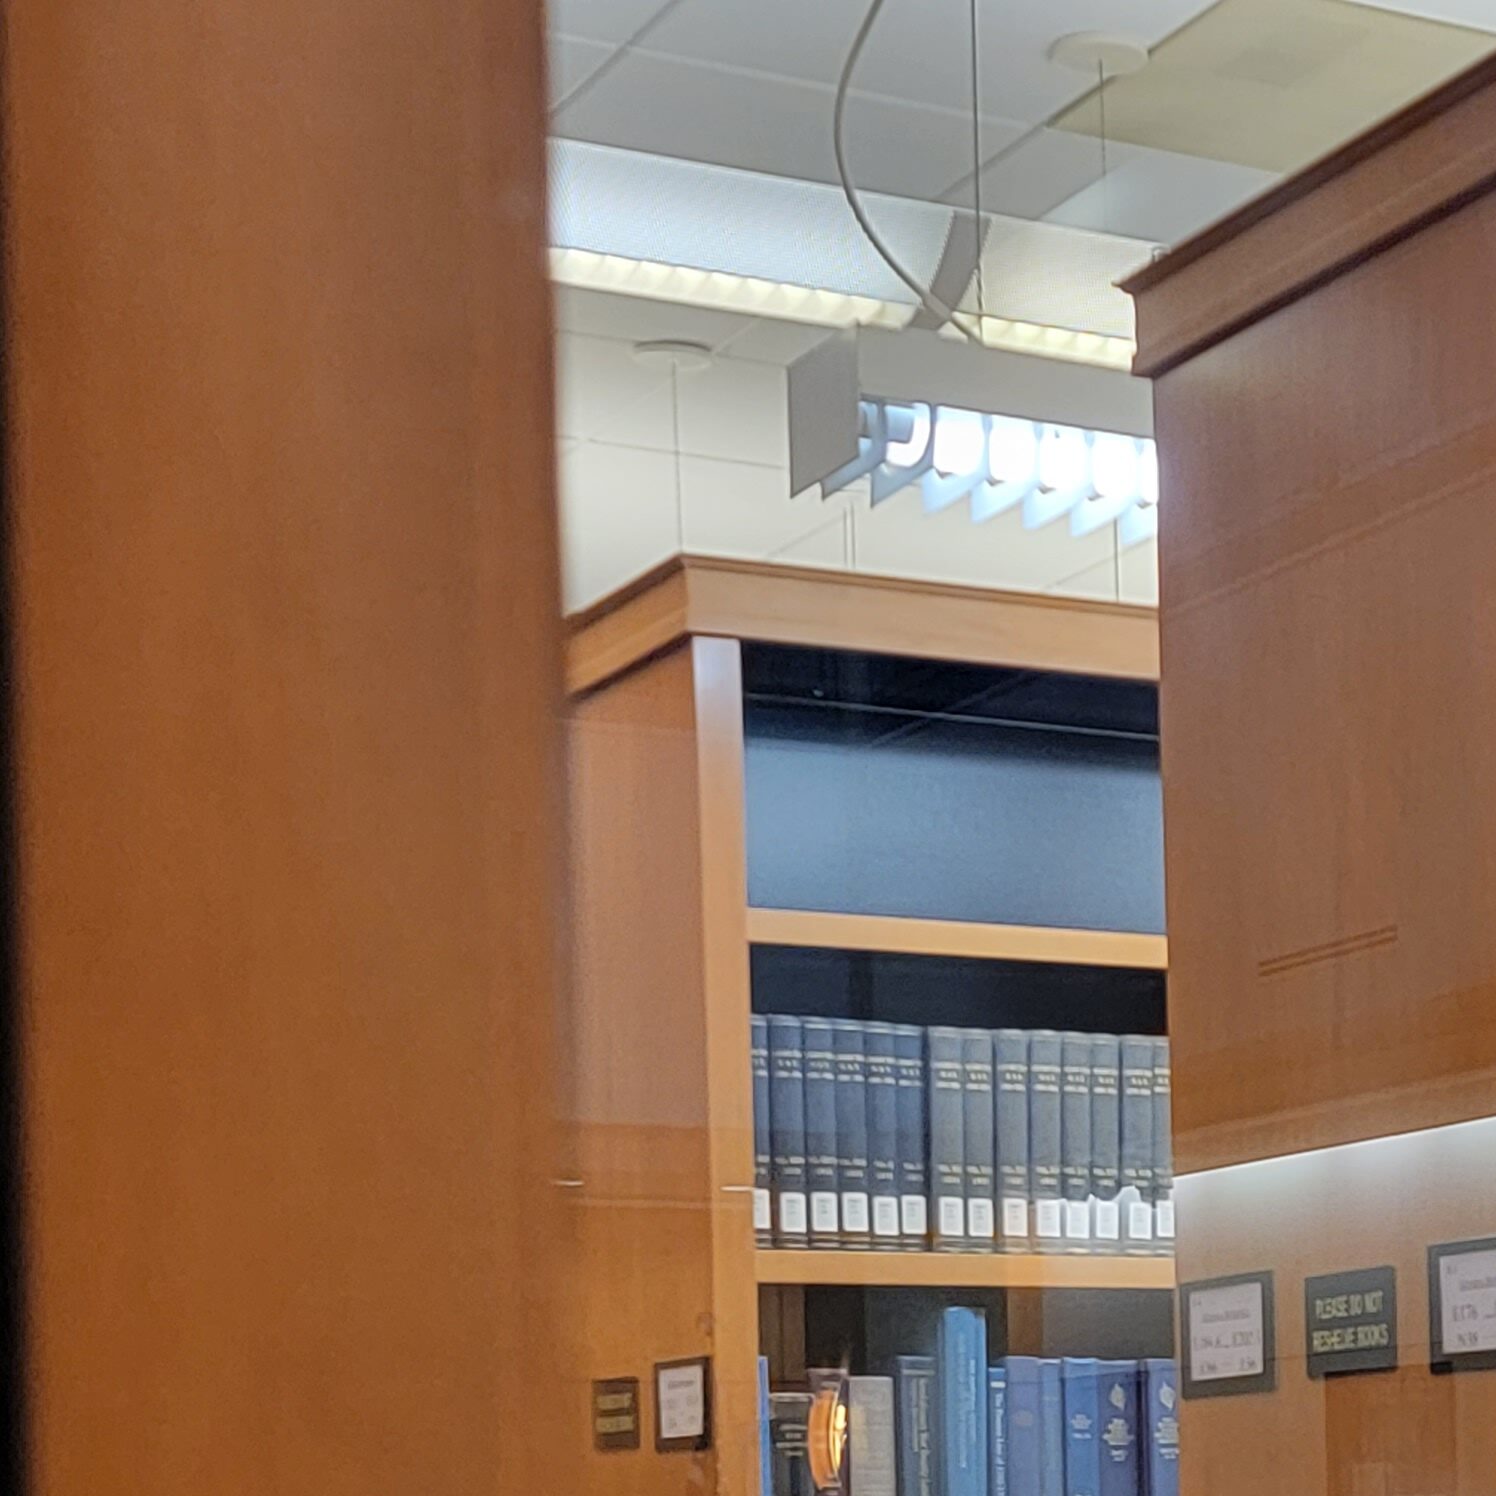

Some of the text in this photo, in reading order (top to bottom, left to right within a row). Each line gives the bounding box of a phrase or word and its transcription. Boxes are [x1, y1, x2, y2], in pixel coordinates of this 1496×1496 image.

[1315, 1289, 1383, 1319] PLEASE DO NOT
[1357, 1323, 1389, 1349] BOOKS
